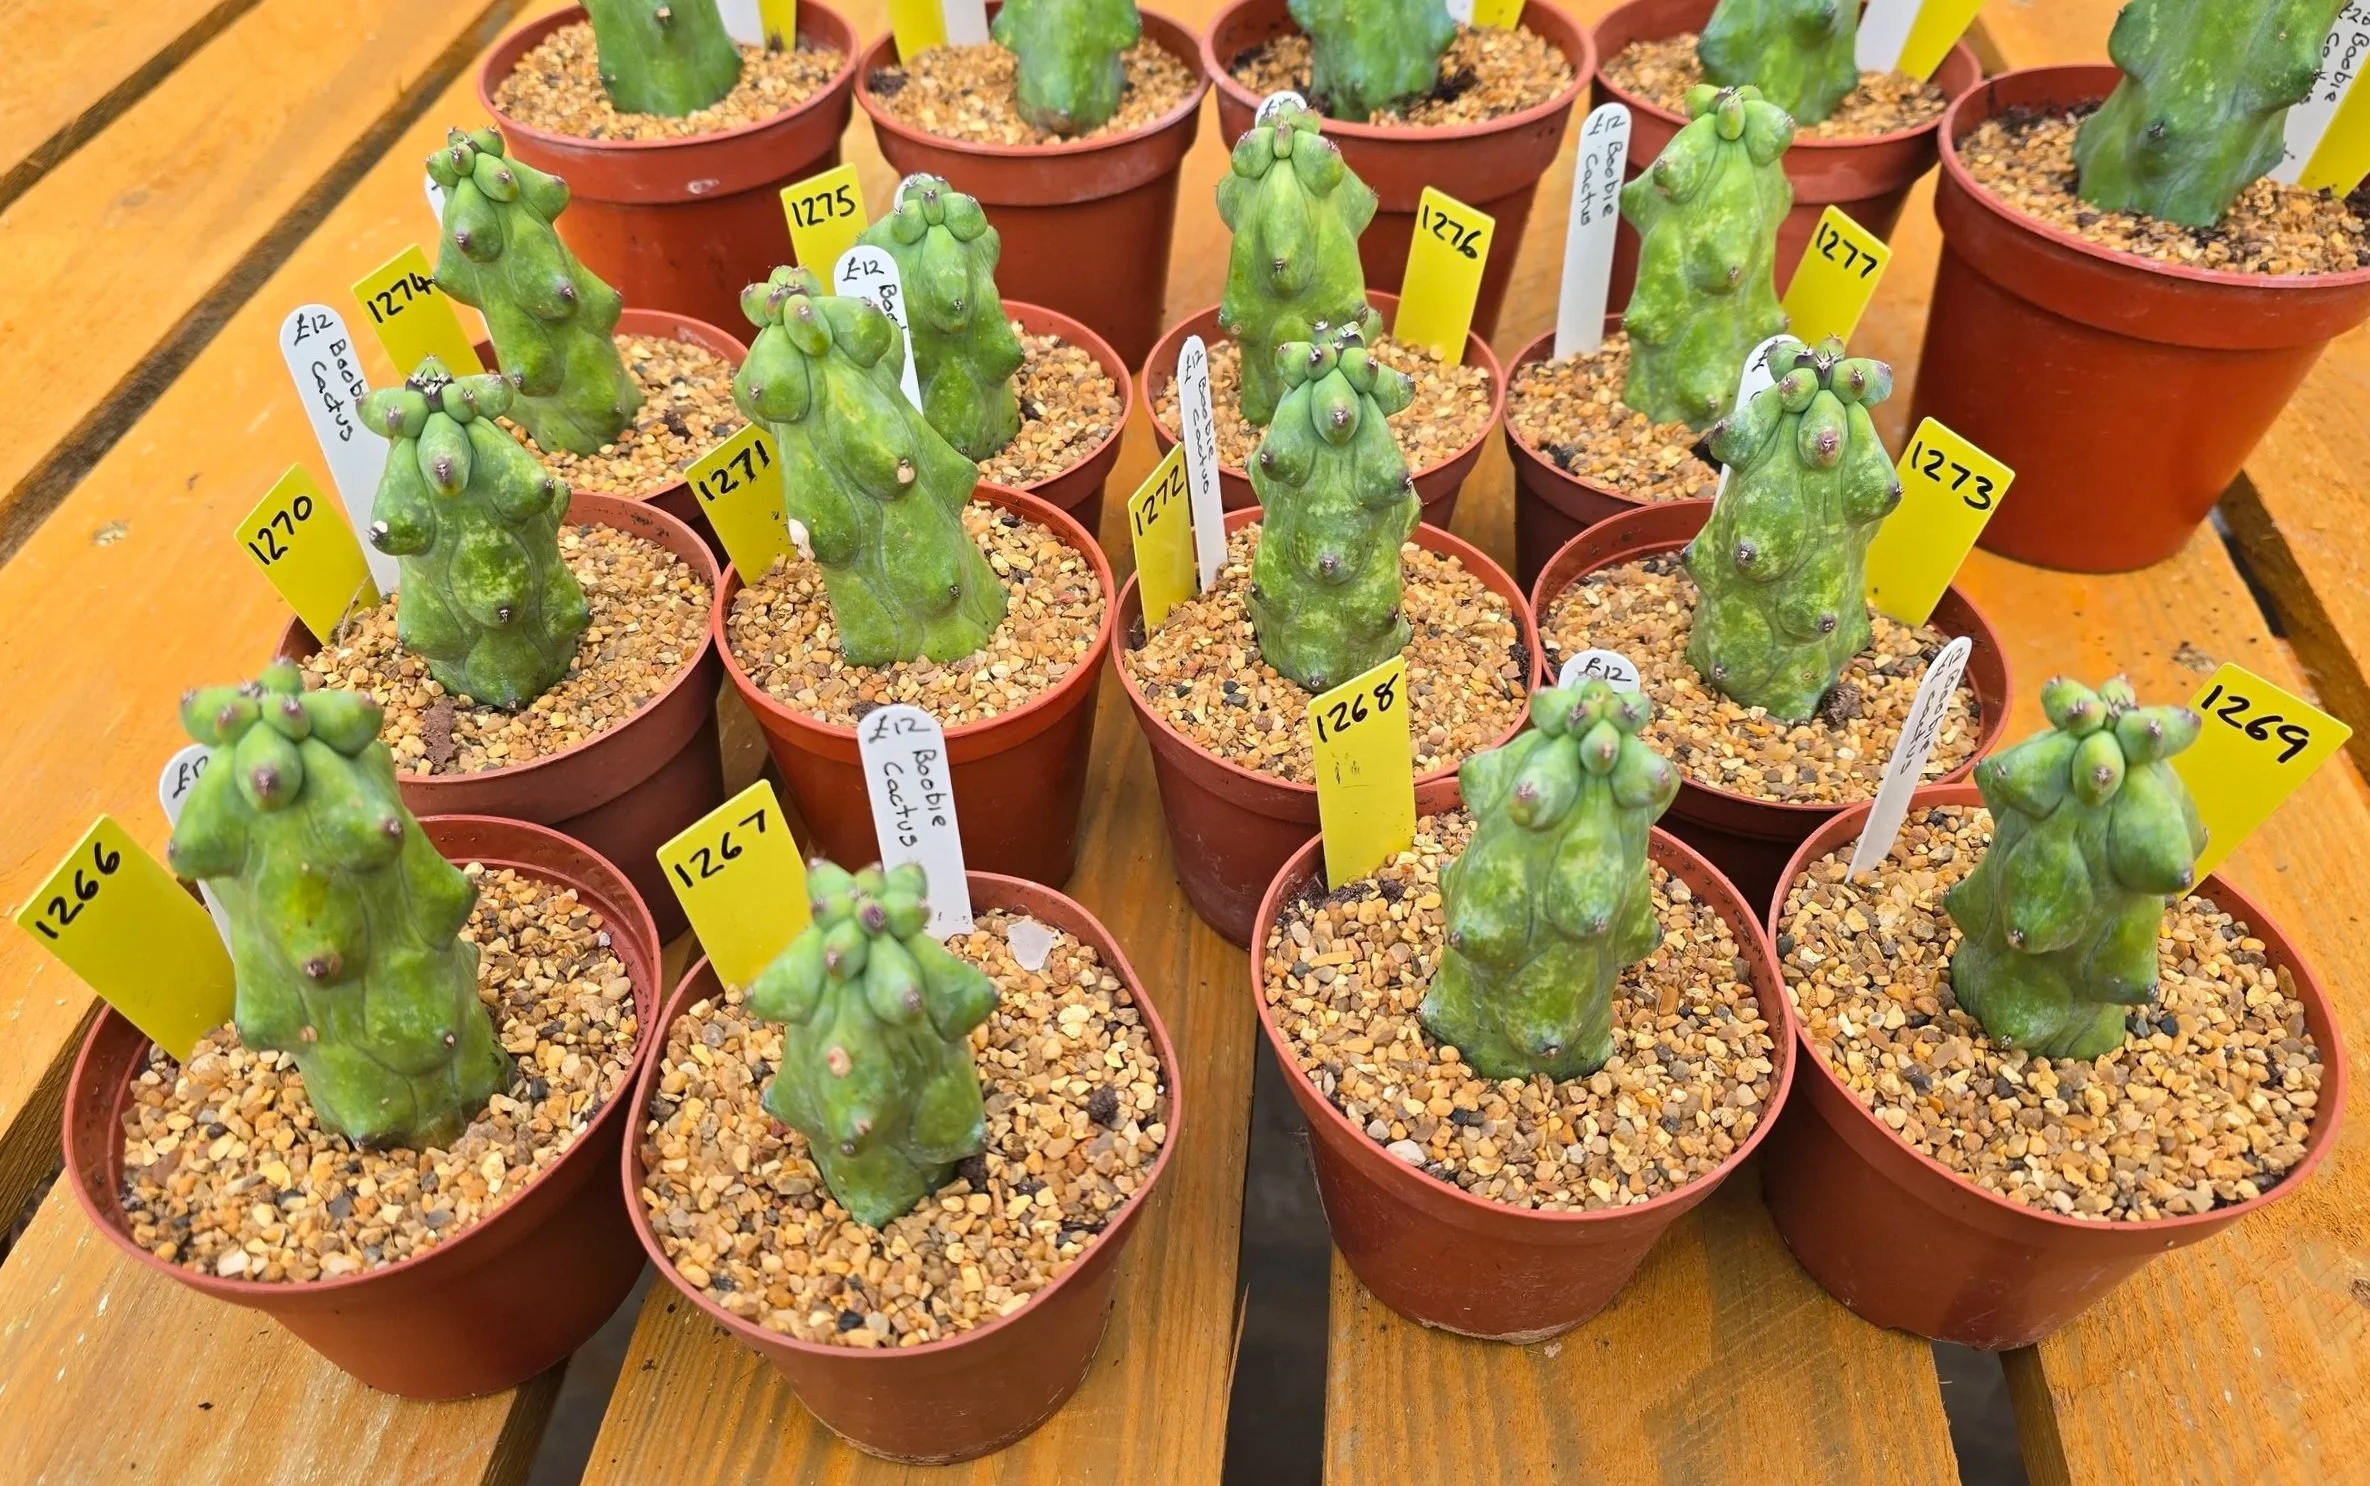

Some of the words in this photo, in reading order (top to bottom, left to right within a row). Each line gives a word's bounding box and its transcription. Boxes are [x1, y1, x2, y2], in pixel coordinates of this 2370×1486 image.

[2324, 32, 2370, 102] Boobie
[1588, 113, 1626, 136] £12
[792, 184, 857, 228] 1275
[1580, 153, 1598, 226] Cactus
[1422, 204, 1482, 260] 1276
[1816, 222, 1878, 279] 1277
[366, 272, 435, 324] 1274
[842, 256, 885, 282] £12
[294, 313, 334, 346] £12
[311, 360, 354, 442] Cactus
[329, 338, 364, 398] Boob
[1185, 350, 1203, 384] £12
[698, 439, 771, 501] 1271
[1192, 408, 1210, 495] Cactus
[1911, 440, 1994, 511] 1273
[248, 495, 313, 566] 1270
[1135, 464, 1185, 537] 1272
[1578, 657, 1632, 682] £12
[1930, 647, 1965, 683] £12
[868, 714, 931, 743] £12
[1316, 672, 1399, 744] 1268
[1900, 689, 1935, 775] Cactus
[1919, 668, 1960, 753] Boobie
[2200, 684, 2310, 765] 1269
[883, 761, 918, 848] Cactus
[912, 749, 947, 827] Boobie
[674, 808, 766, 889] 1267
[35, 841, 121, 940] 1266
